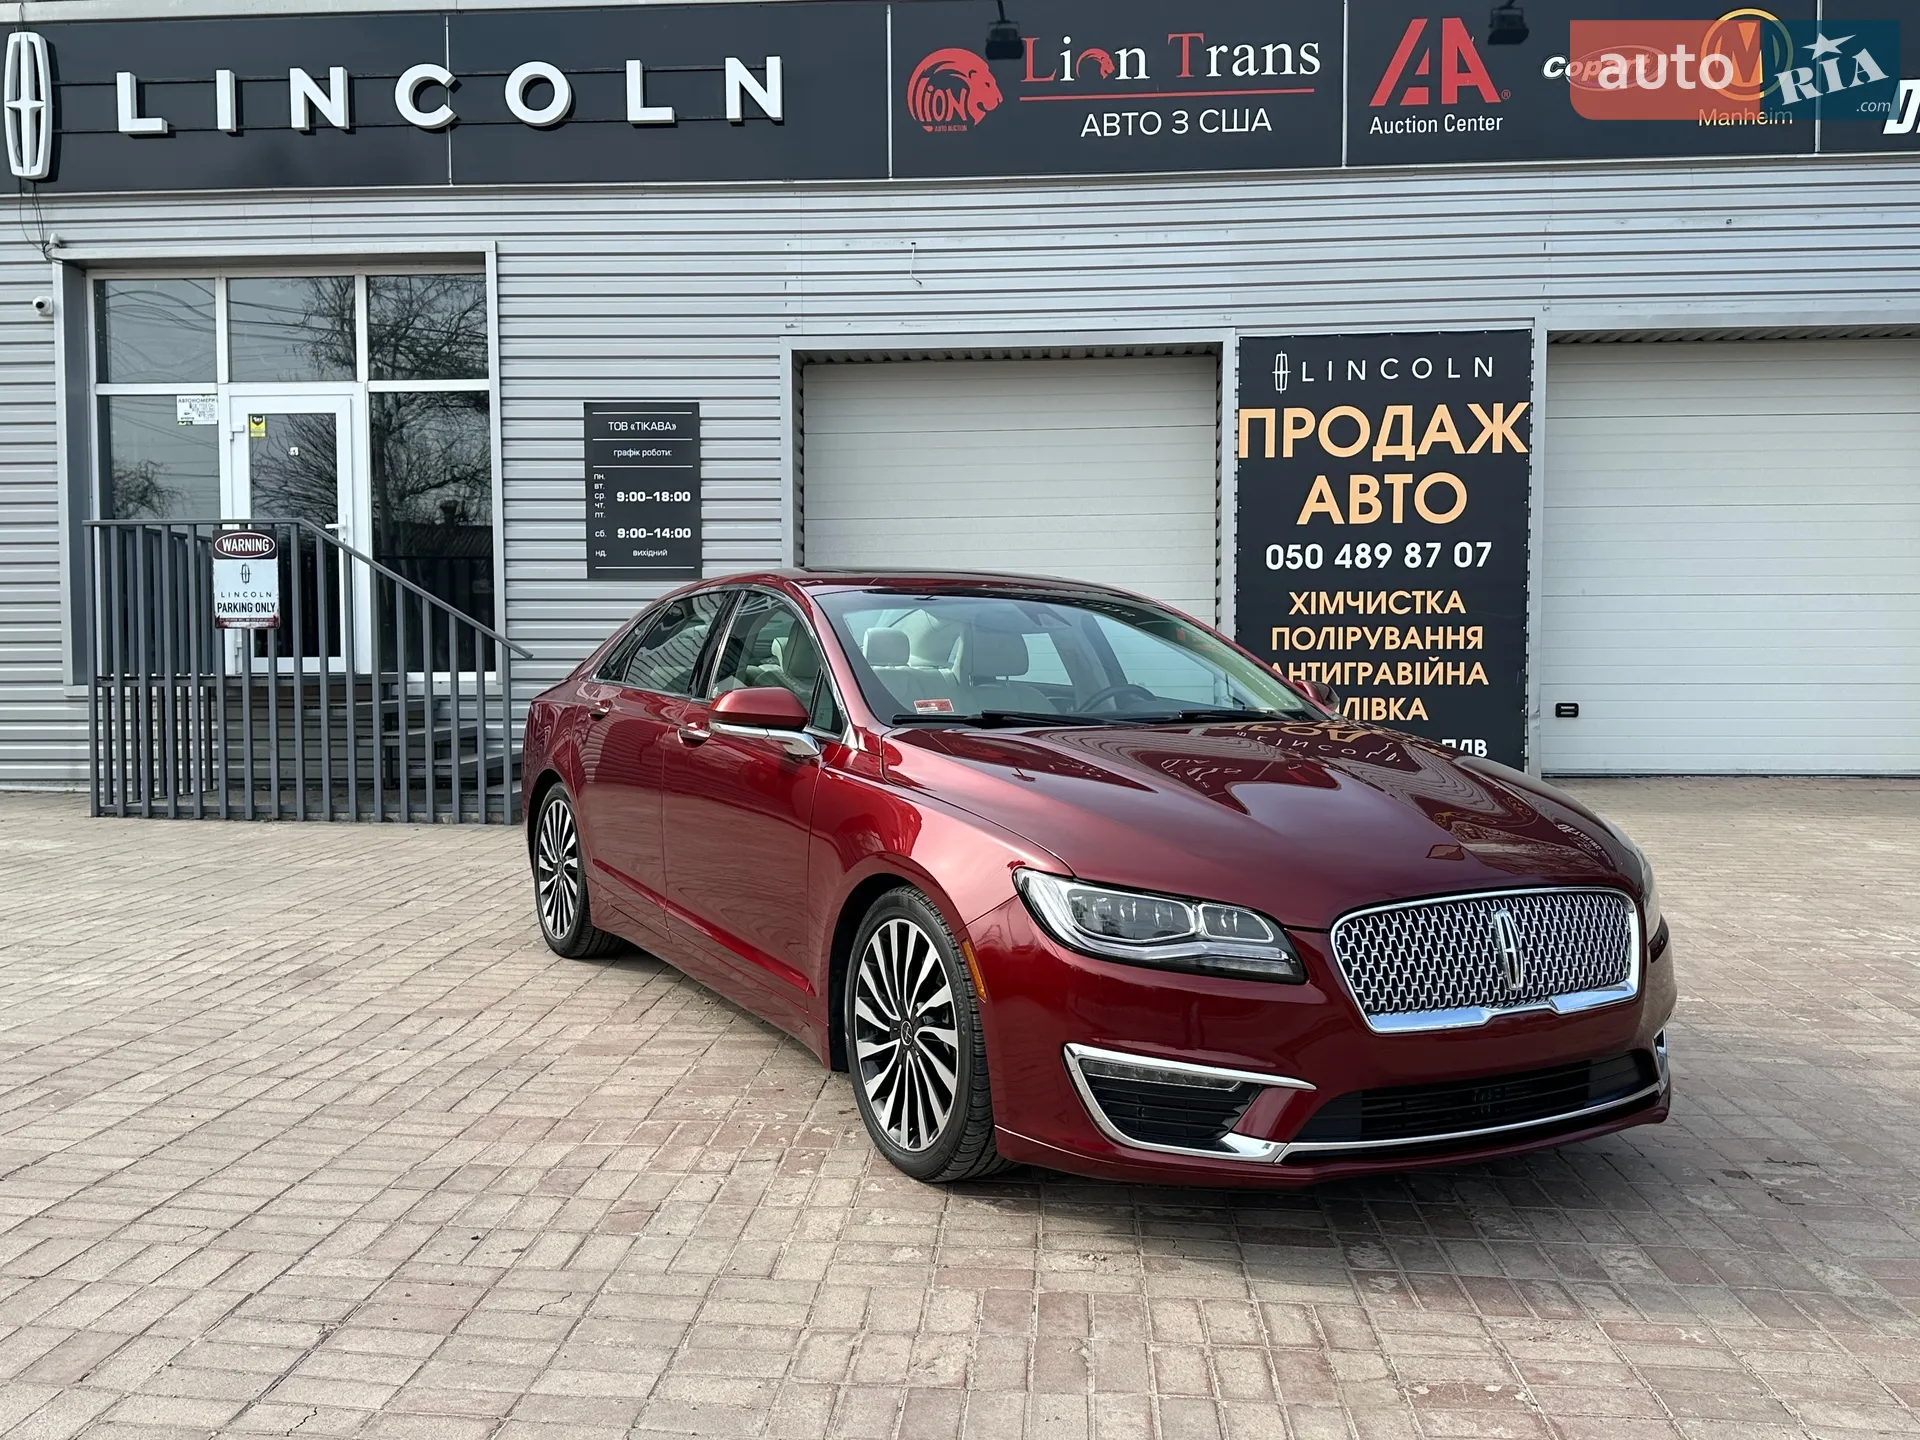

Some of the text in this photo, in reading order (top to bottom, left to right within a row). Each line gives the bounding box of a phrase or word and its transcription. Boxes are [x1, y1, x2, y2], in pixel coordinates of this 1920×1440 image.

[1167, 32, 1322, 78] Trans
[116, 56, 783, 135] LINCOLN
[1081, 111, 1162, 137] АВТО
[1199, 107, 1272, 133] США
[1369, 113, 1503, 134] Auction Center
[1699, 107, 1793, 126] Manheim
[1301, 356, 1494, 382] LINCOLN
[608, 421, 677, 431] ТОВ «ТІКАВА»
[1238, 401, 1530, 462] ПРОДАЖ
[613, 448, 672, 458] графік роботи:
[1296, 471, 1468, 526] АВТО
[222, 538, 269, 552] WARNING
[632, 548, 668, 558] вихідний
[1265, 541, 1492, 570] 050 489 87 07
[217, 602, 276, 613] PARKING ONLY
[1288, 590, 1466, 615] ХІМЧИСТКА
[1271, 626, 1484, 651] ПОЛІРУВАННЯ
[1271, 656, 1490, 686] НТИГРАВІЙНА
[1335, 697, 1429, 721] ЛІВКА
